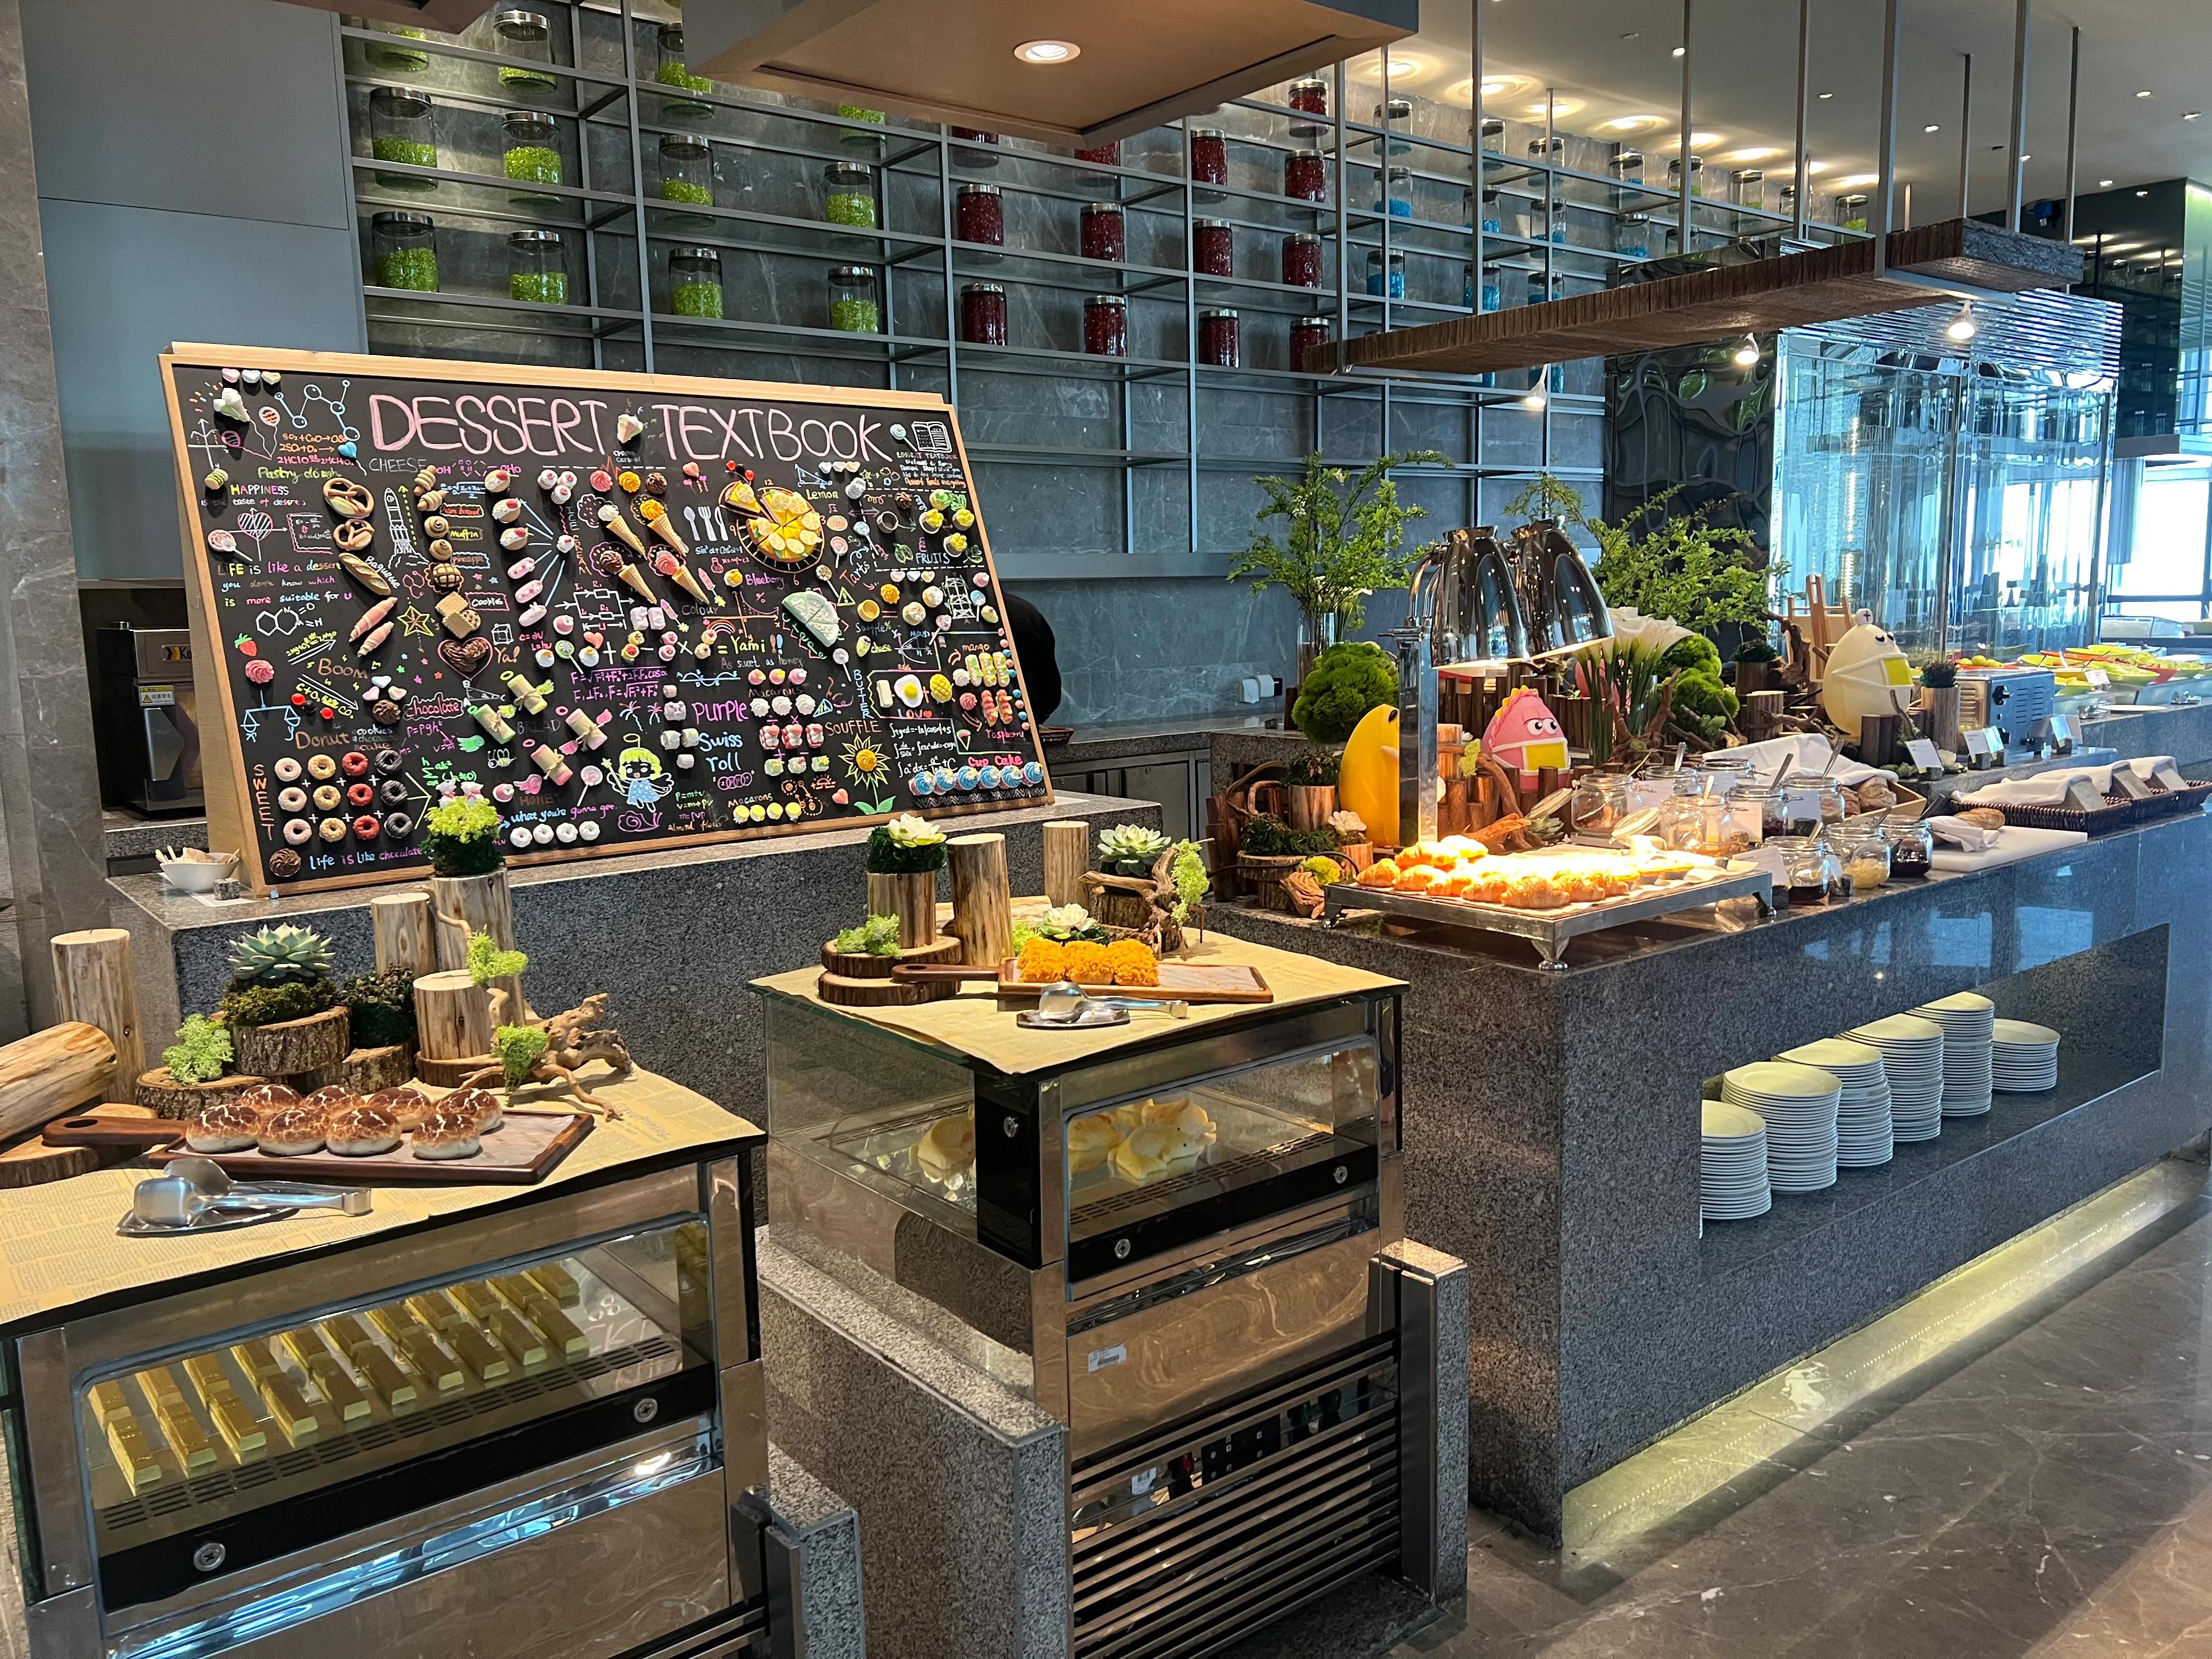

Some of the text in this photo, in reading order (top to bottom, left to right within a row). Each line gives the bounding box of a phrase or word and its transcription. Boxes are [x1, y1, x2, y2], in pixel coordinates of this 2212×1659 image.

[370, 394, 893, 462] DESSERT TEXTBOOK
[369, 458, 428, 474] CHEESE
[258, 465, 302, 484] Pastry
[230, 484, 290, 496] HAPPINESS
[805, 488, 839, 500] Lemon
[233, 498, 256, 506] taste
[259, 498, 269, 507] of
[820, 515, 826, 524] 3
[730, 524, 737, 536] 9
[573, 534, 592, 575] CREAM
[915, 552, 950, 565] FRUITS
[267, 561, 290, 574] like
[306, 559, 342, 572] dessert
[364, 555, 401, 589] Baguette
[839, 560, 871, 587] Tarts
[221, 582, 241, 593] you
[281, 579, 303, 588] know
[308, 575, 336, 585] which
[246, 597, 272, 605] more
[279, 591, 321, 603] suitable
[324, 591, 340, 603] for
[494, 646, 520, 664] Ya!
[962, 644, 990, 653] mango
[749, 687, 803, 698] Macarons
[853, 669, 874, 719] BUTTER
[405, 696, 460, 718] chocolate
[825, 720, 882, 736] SOUFFLE
[295, 731, 350, 749] Donut
[698, 731, 743, 752] Swiss
[706, 752, 742, 772] roll
[967, 756, 989, 767] Cup
[253, 763, 274, 842] SWEET
[727, 792, 774, 808] Macarons
[510, 811, 539, 823] what
[570, 806, 597, 820] gonna
